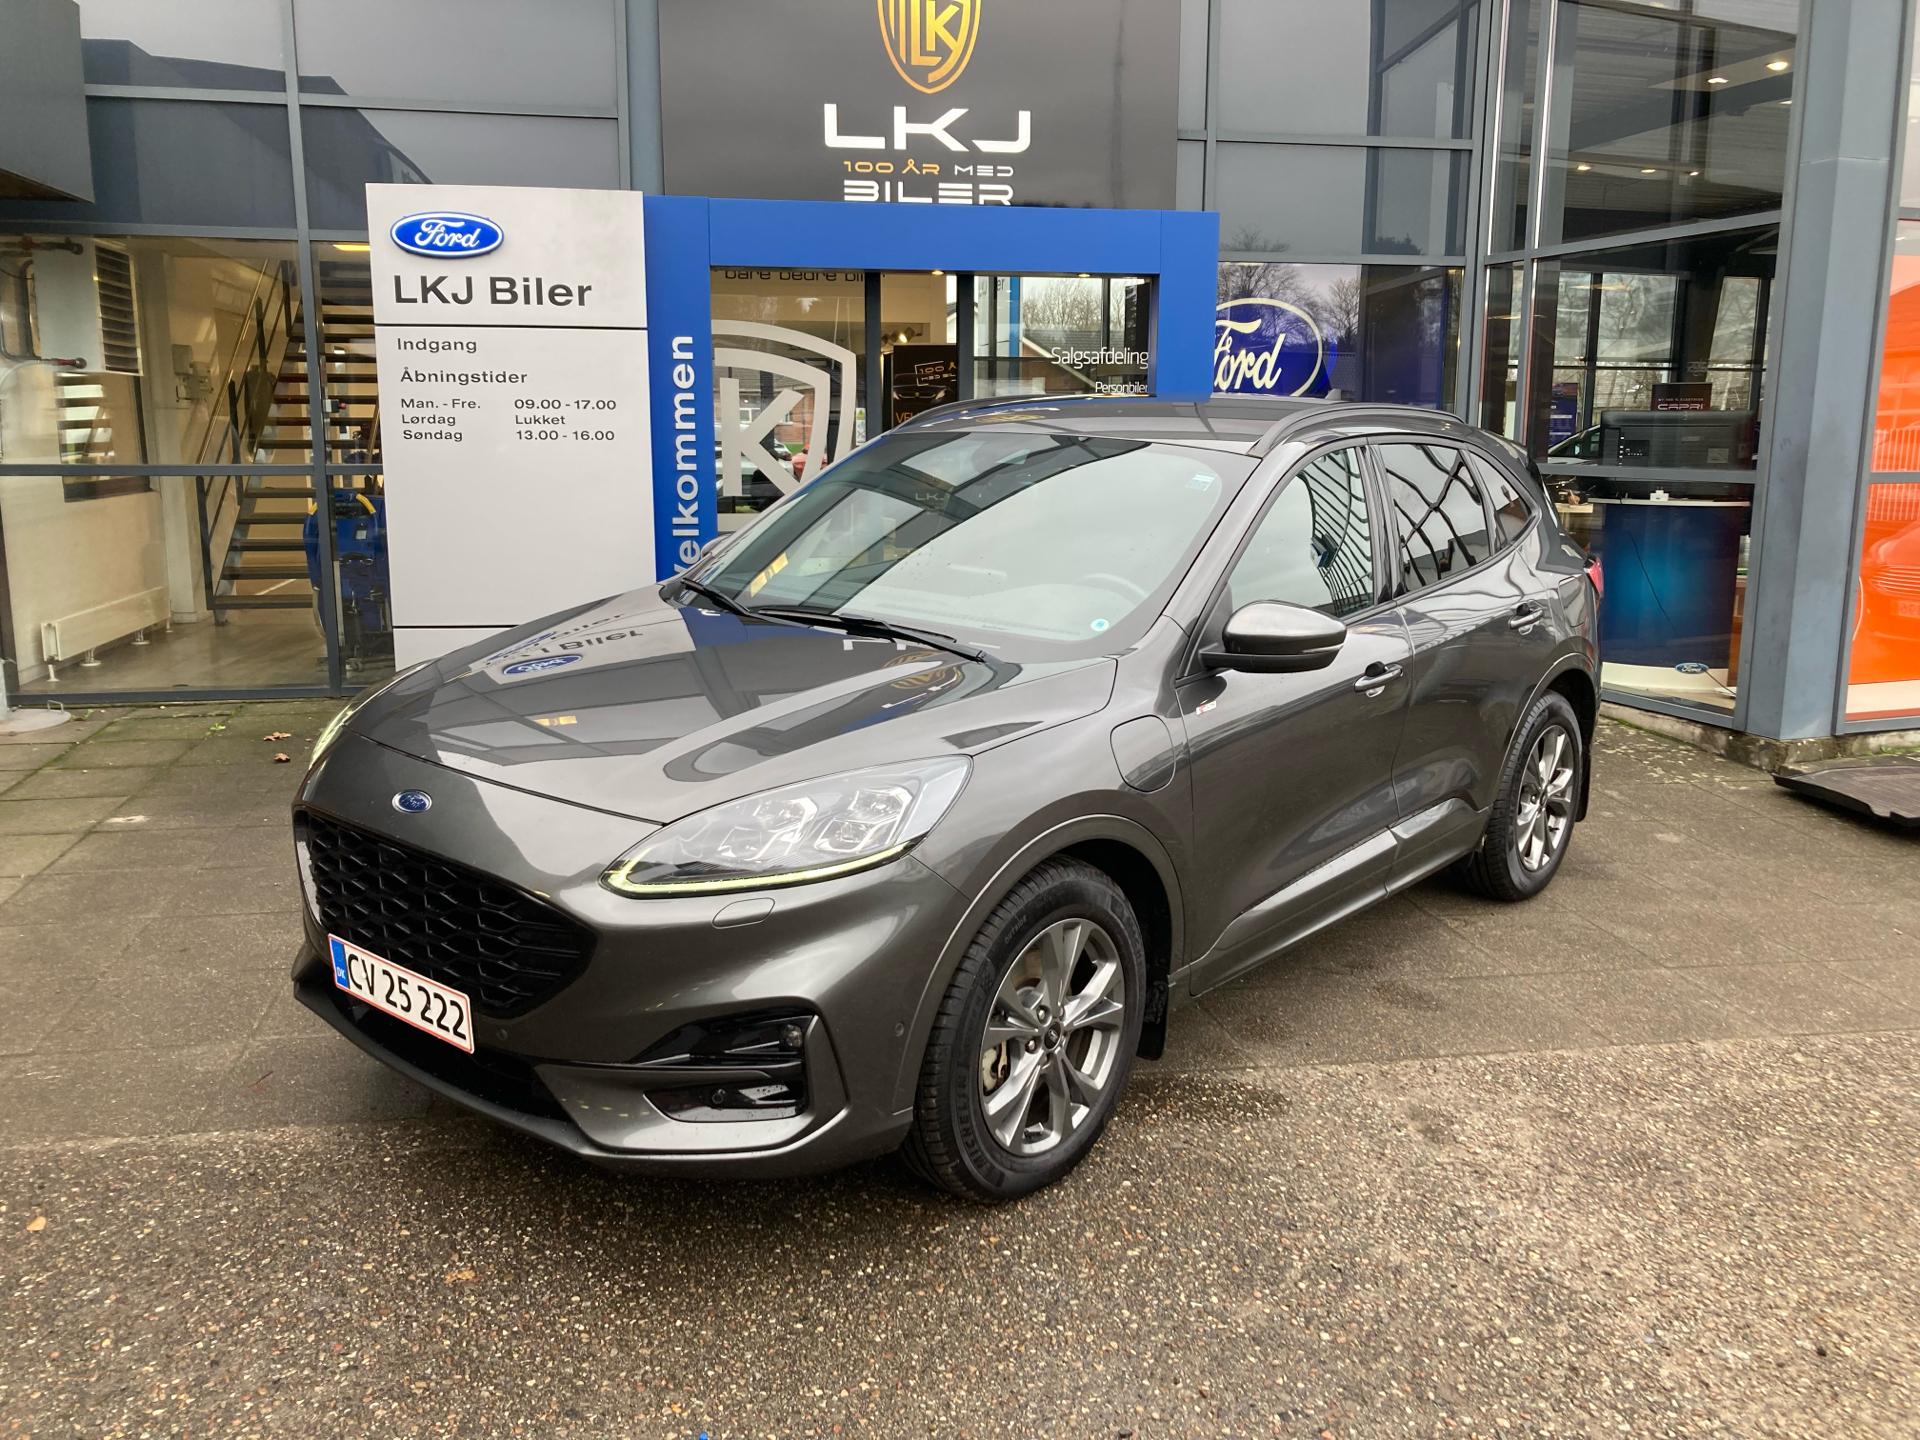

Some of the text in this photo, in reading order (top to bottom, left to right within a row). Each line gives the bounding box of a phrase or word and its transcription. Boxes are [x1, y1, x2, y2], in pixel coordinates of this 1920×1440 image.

[824, 103, 1031, 153] LKJ
[843, 158, 1014, 177] 100 ÅR MED
[843, 179, 1014, 206] BILER
[414, 219, 481, 248] Ford
[393, 275, 592, 306] LKJ Biler
[397, 337, 477, 354] Indgang
[1051, 346, 1149, 370] Salgsafdeling
[400, 366, 528, 386] Åbningstider
[401, 398, 439, 409] Man.
[451, 398, 481, 409] Fre.
[514, 398, 561, 410] 09.00
[573, 399, 617, 410] 17.00
[401, 414, 566, 427] Lørdag Lukket
[403, 429, 463, 443] Søndag
[516, 430, 559, 441] 13.00
[572, 430, 615, 441] 16.00
[336, 966, 346, 980] DK
[347, 953, 467, 1041] CV 25 222
